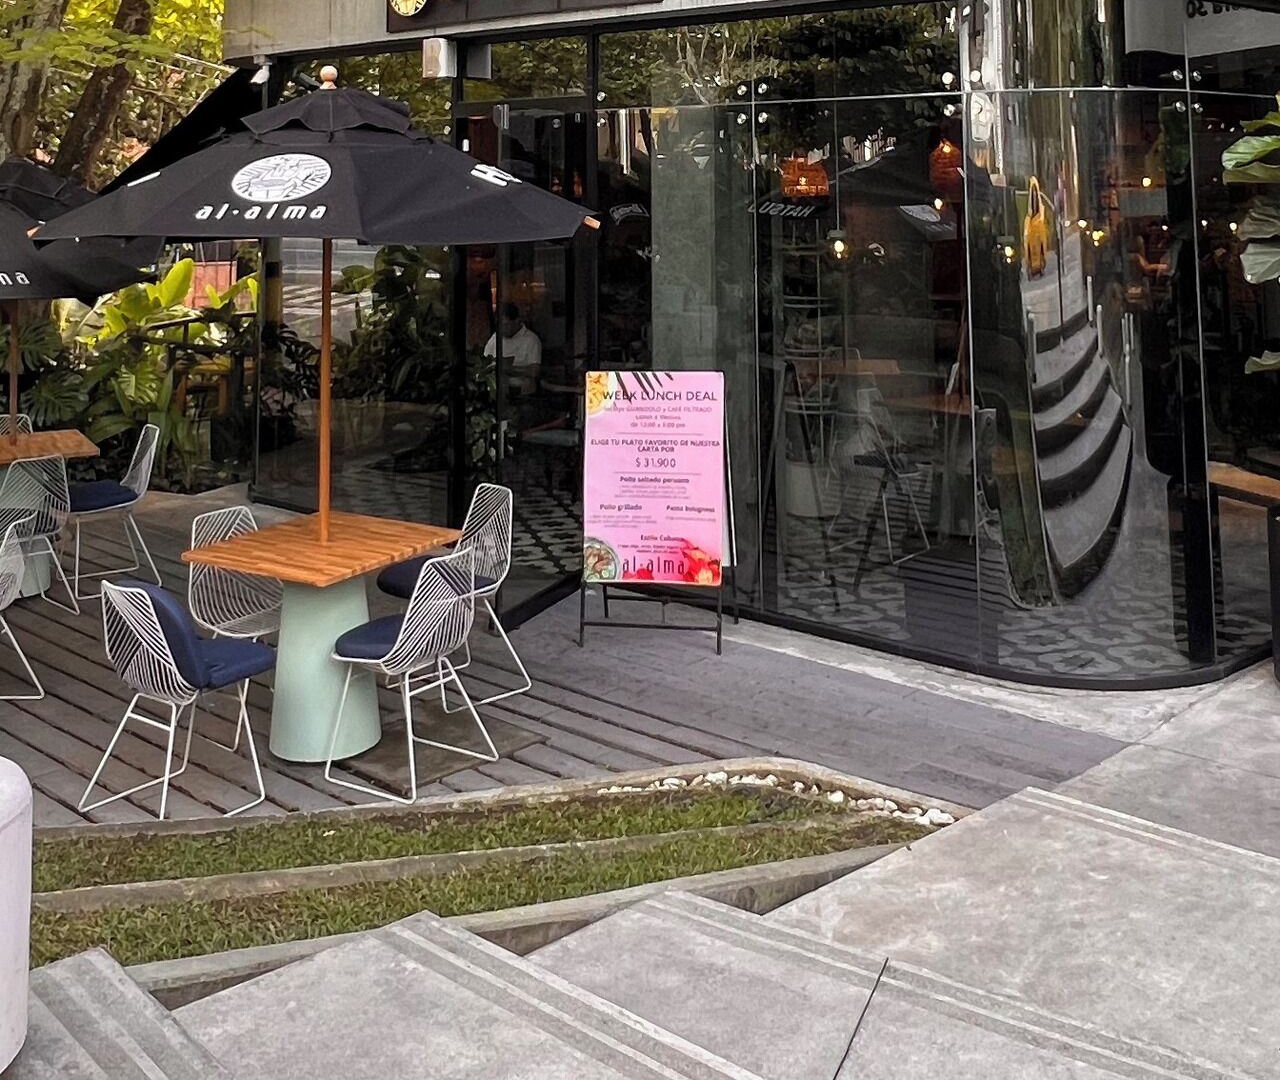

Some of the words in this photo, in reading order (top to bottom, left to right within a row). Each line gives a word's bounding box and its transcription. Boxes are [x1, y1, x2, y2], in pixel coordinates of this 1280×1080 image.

[602, 391, 638, 401] WEEK
[641, 391, 682, 401] LUNCH
[686, 391, 718, 401] DEAL
[635, 457, 641, 468] $
[644, 458, 677, 469] 31.900
